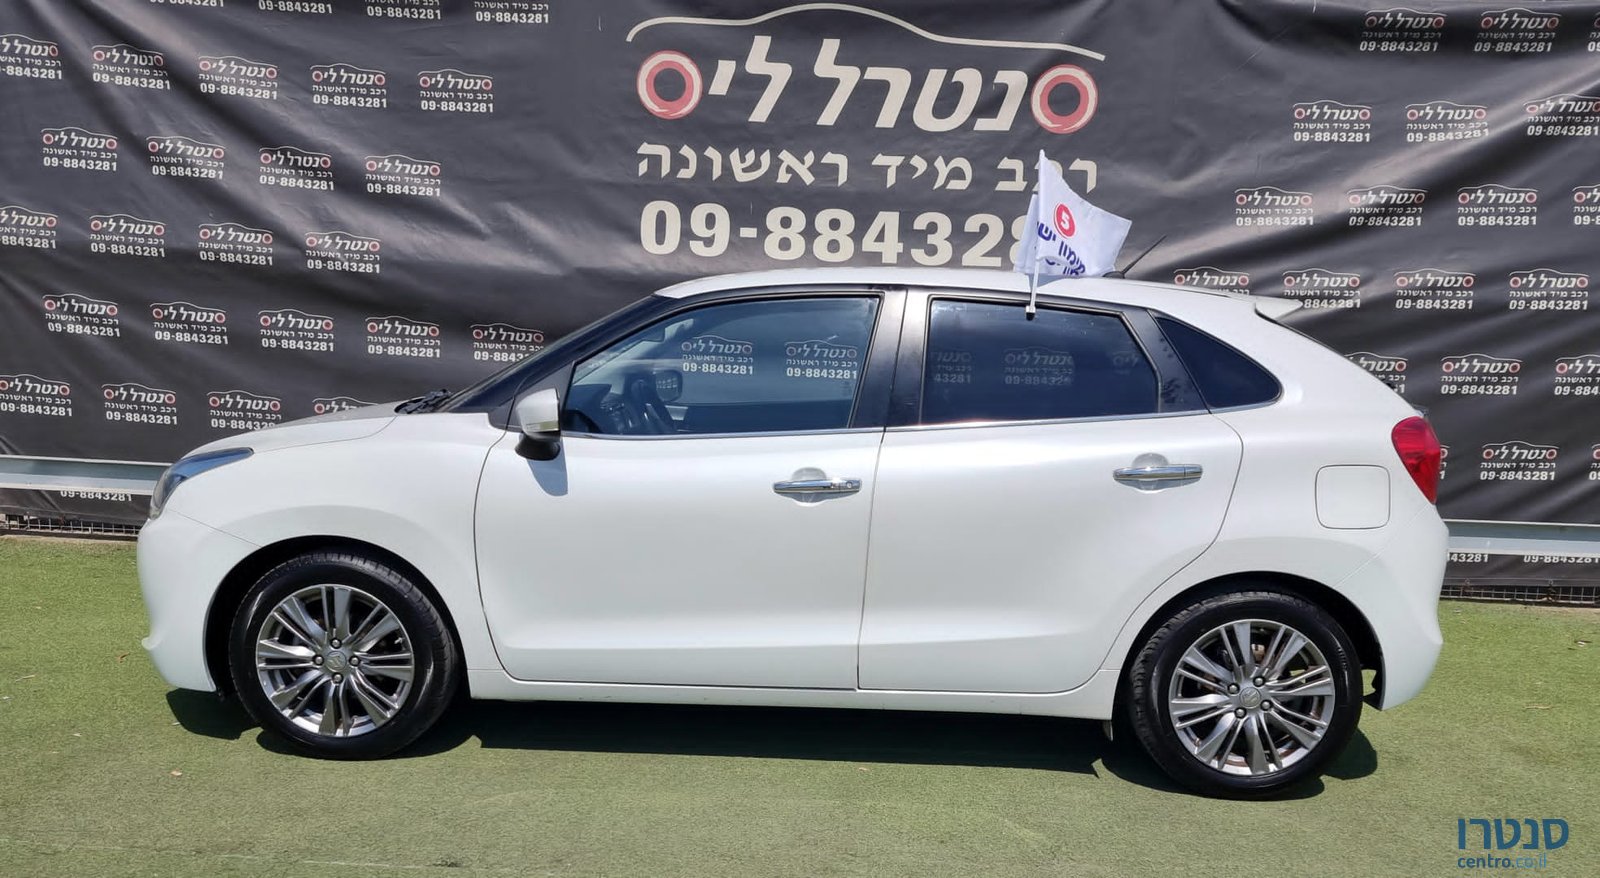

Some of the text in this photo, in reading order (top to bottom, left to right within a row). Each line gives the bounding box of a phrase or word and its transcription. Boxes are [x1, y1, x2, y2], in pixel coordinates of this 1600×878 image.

[367, 6, 441, 20] 09-8843281
[476, 11, 549, 24] 09-8843281
[1360, 41, 1438, 52] 09-8843281
[1474, 42, 1552, 53] 09-8843281
[94, 73, 171, 90] 09-8843281
[199, 83, 277, 100] 09-8843281
[312, 85, 347, 93] ראשונה
[313, 94, 387, 108] 09-8843281
[421, 100, 493, 113] 09-8843281
[1294, 132, 1370, 142] 09-8843281
[1406, 129, 1489, 142] 09-8843281
[1527, 126, 1599, 136] 09-8843281
[43, 147, 78, 156] ראשונה
[43, 157, 117, 171] 09-8843281
[637, 142, 849, 188] ראשונה
[152, 164, 224, 179] 09-8843281
[872, 153, 972, 190] מיד
[259, 175, 334, 190] 09-8843281
[366, 174, 401, 182] ראשונה
[366, 183, 440, 197] 09-8843281
[1236, 217, 1313, 226] 09-8843281
[1348, 216, 1422, 226] 09-8843281
[1458, 216, 1537, 226] 09-8843281
[90, 234, 125, 242] ראשונה
[91, 243, 165, 257] 09-8843281
[199, 242, 234, 250] ראשונה
[200, 251, 273, 265] 09-8843281
[307, 259, 380, 273] 09-8843281
[1395, 299, 1473, 309] 09-8843281
[1509, 300, 1588, 310] 09-8843281
[46, 313, 80, 322] ראשונה
[47, 322, 121, 337] 09-8843281
[154, 322, 188, 330] ראשונה
[155, 331, 229, 345] 09-8843281
[260, 329, 295, 337] ראשונה
[261, 338, 334, 352] 09-8843281
[368, 345, 440, 358] 09-8843281
[683, 363, 753, 374] 09-8843281
[786, 367, 857, 379] 09-8843281
[1440, 385, 1518, 395] 09-8843281
[0, 402, 72, 417] 09-8843281
[104, 402, 138, 410] ראשונה
[106, 411, 178, 425] 09-8843281
[1479, 471, 1555, 481] 09-8843281
